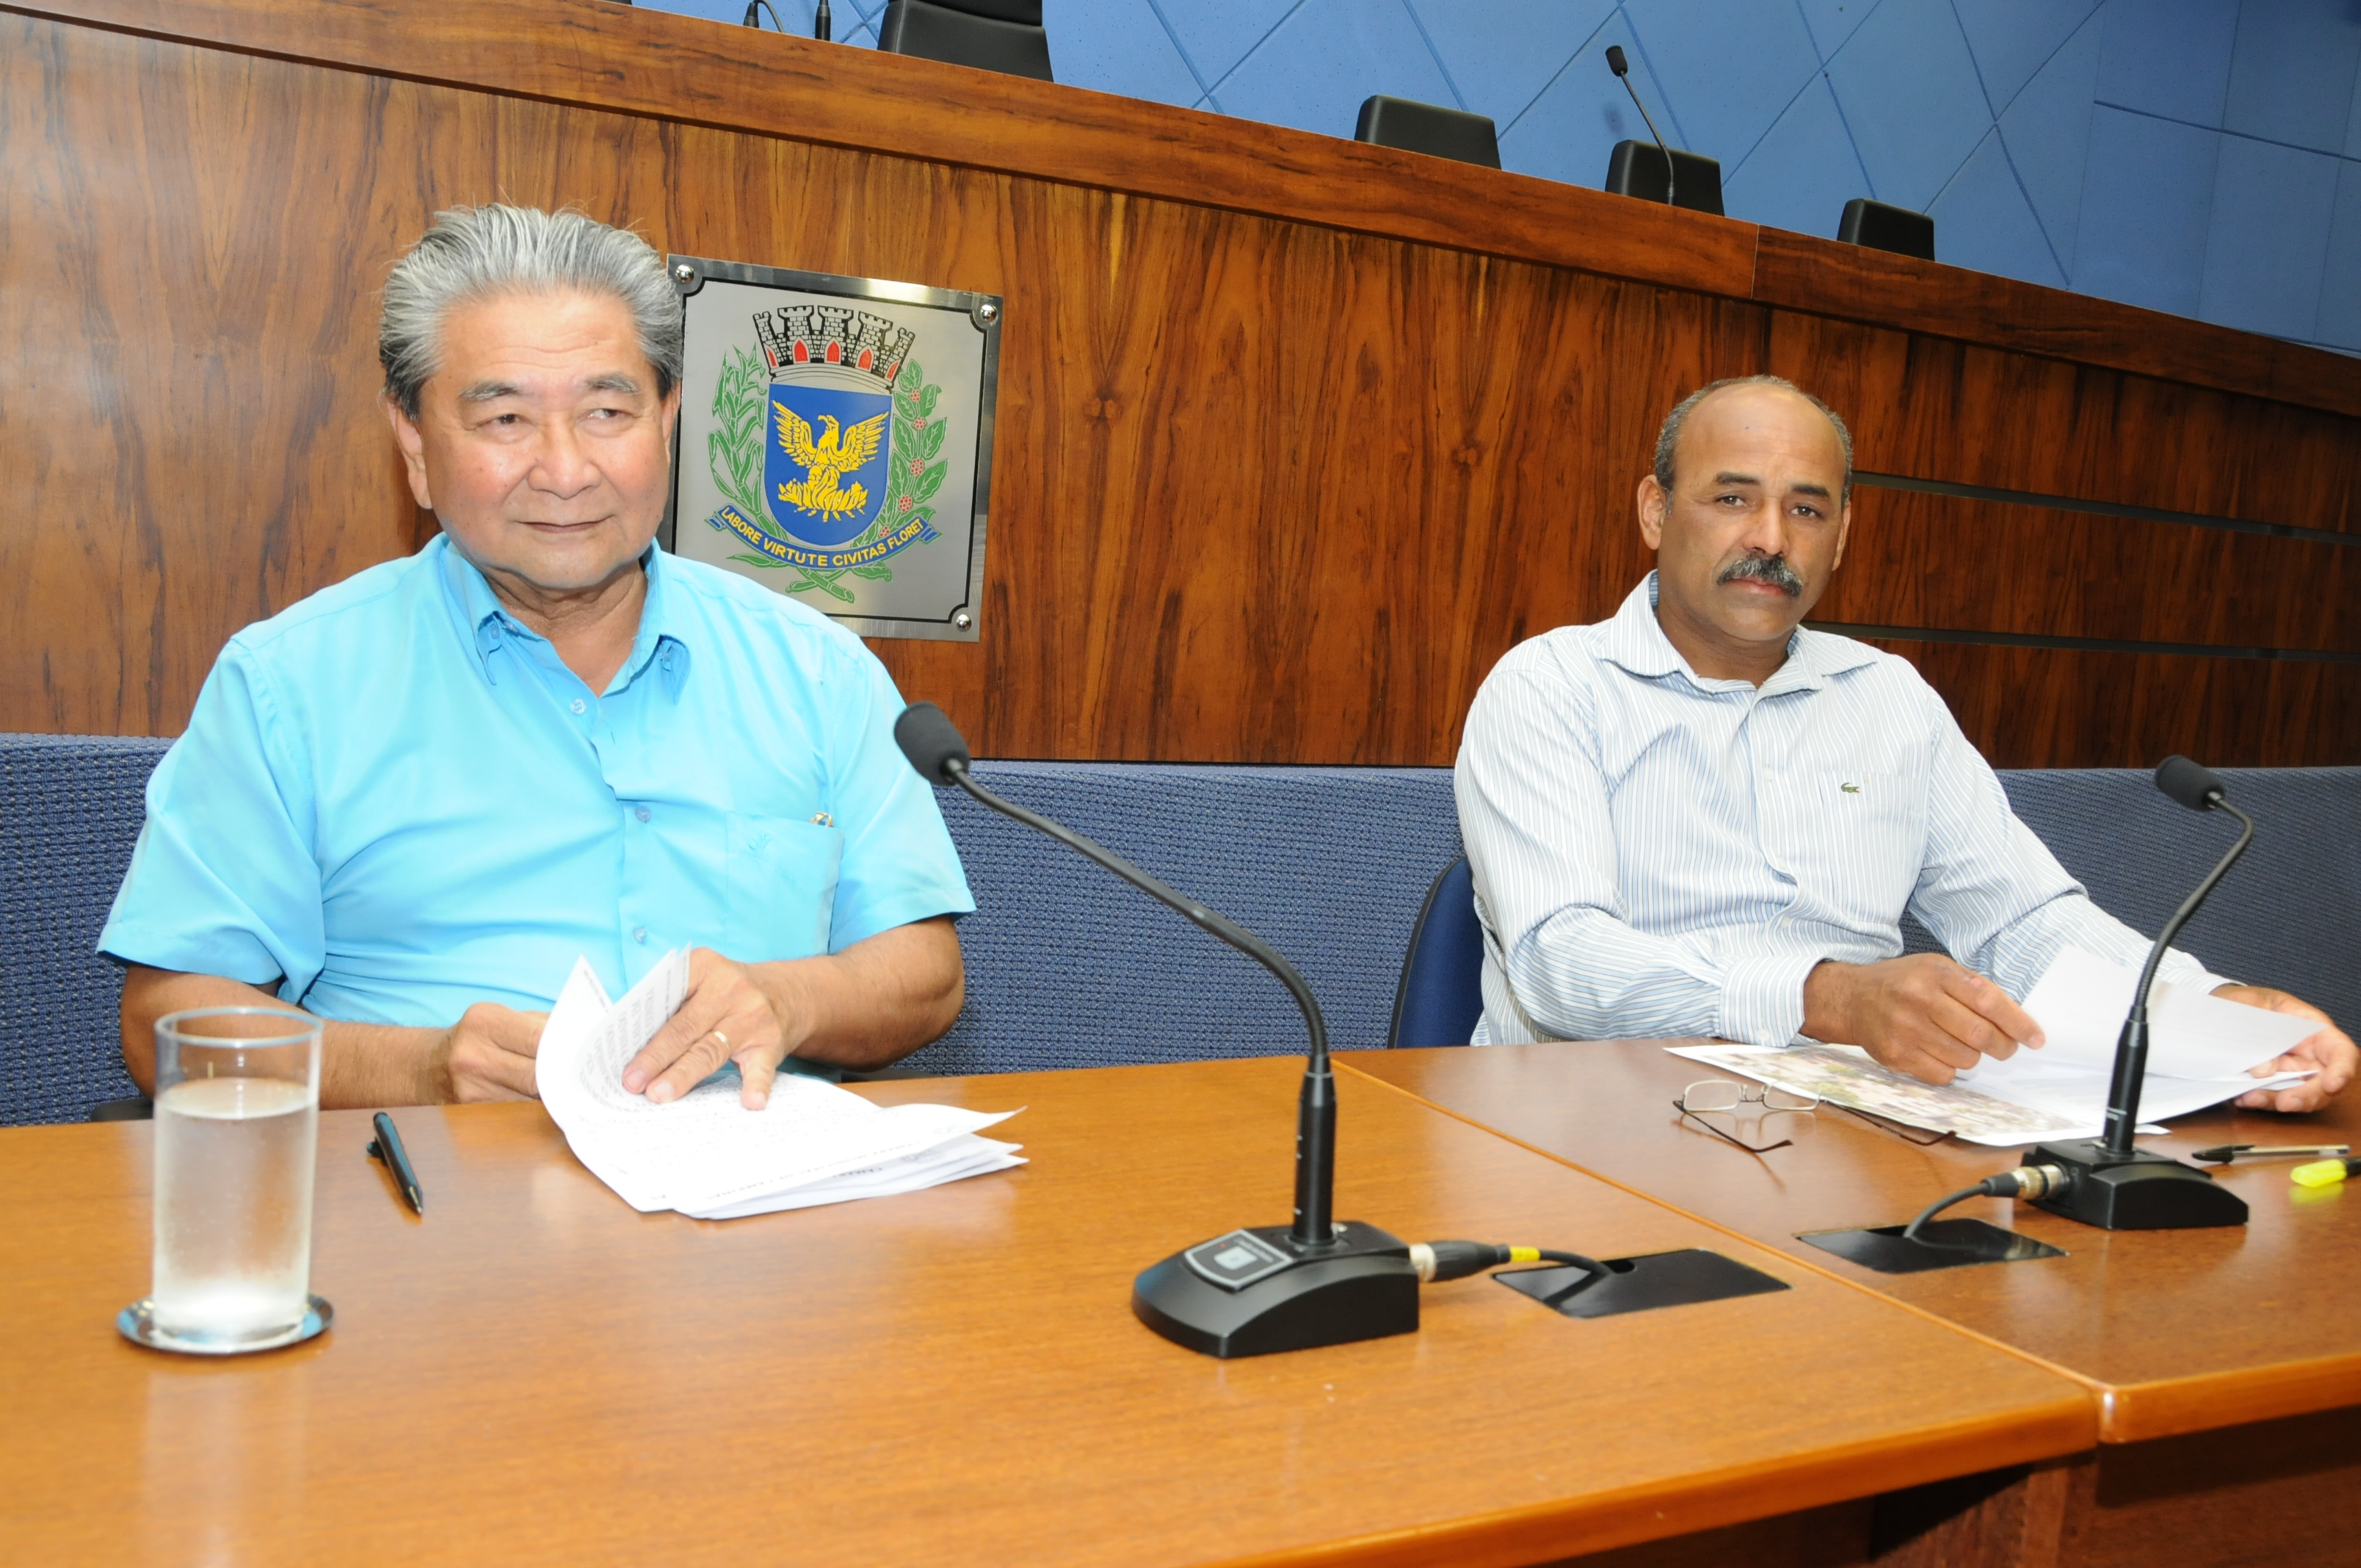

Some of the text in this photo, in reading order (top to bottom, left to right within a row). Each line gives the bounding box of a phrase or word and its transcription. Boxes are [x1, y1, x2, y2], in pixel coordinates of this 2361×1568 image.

[721, 507, 924, 567] LABORE VIRTUTE CIVITAS FLORET
